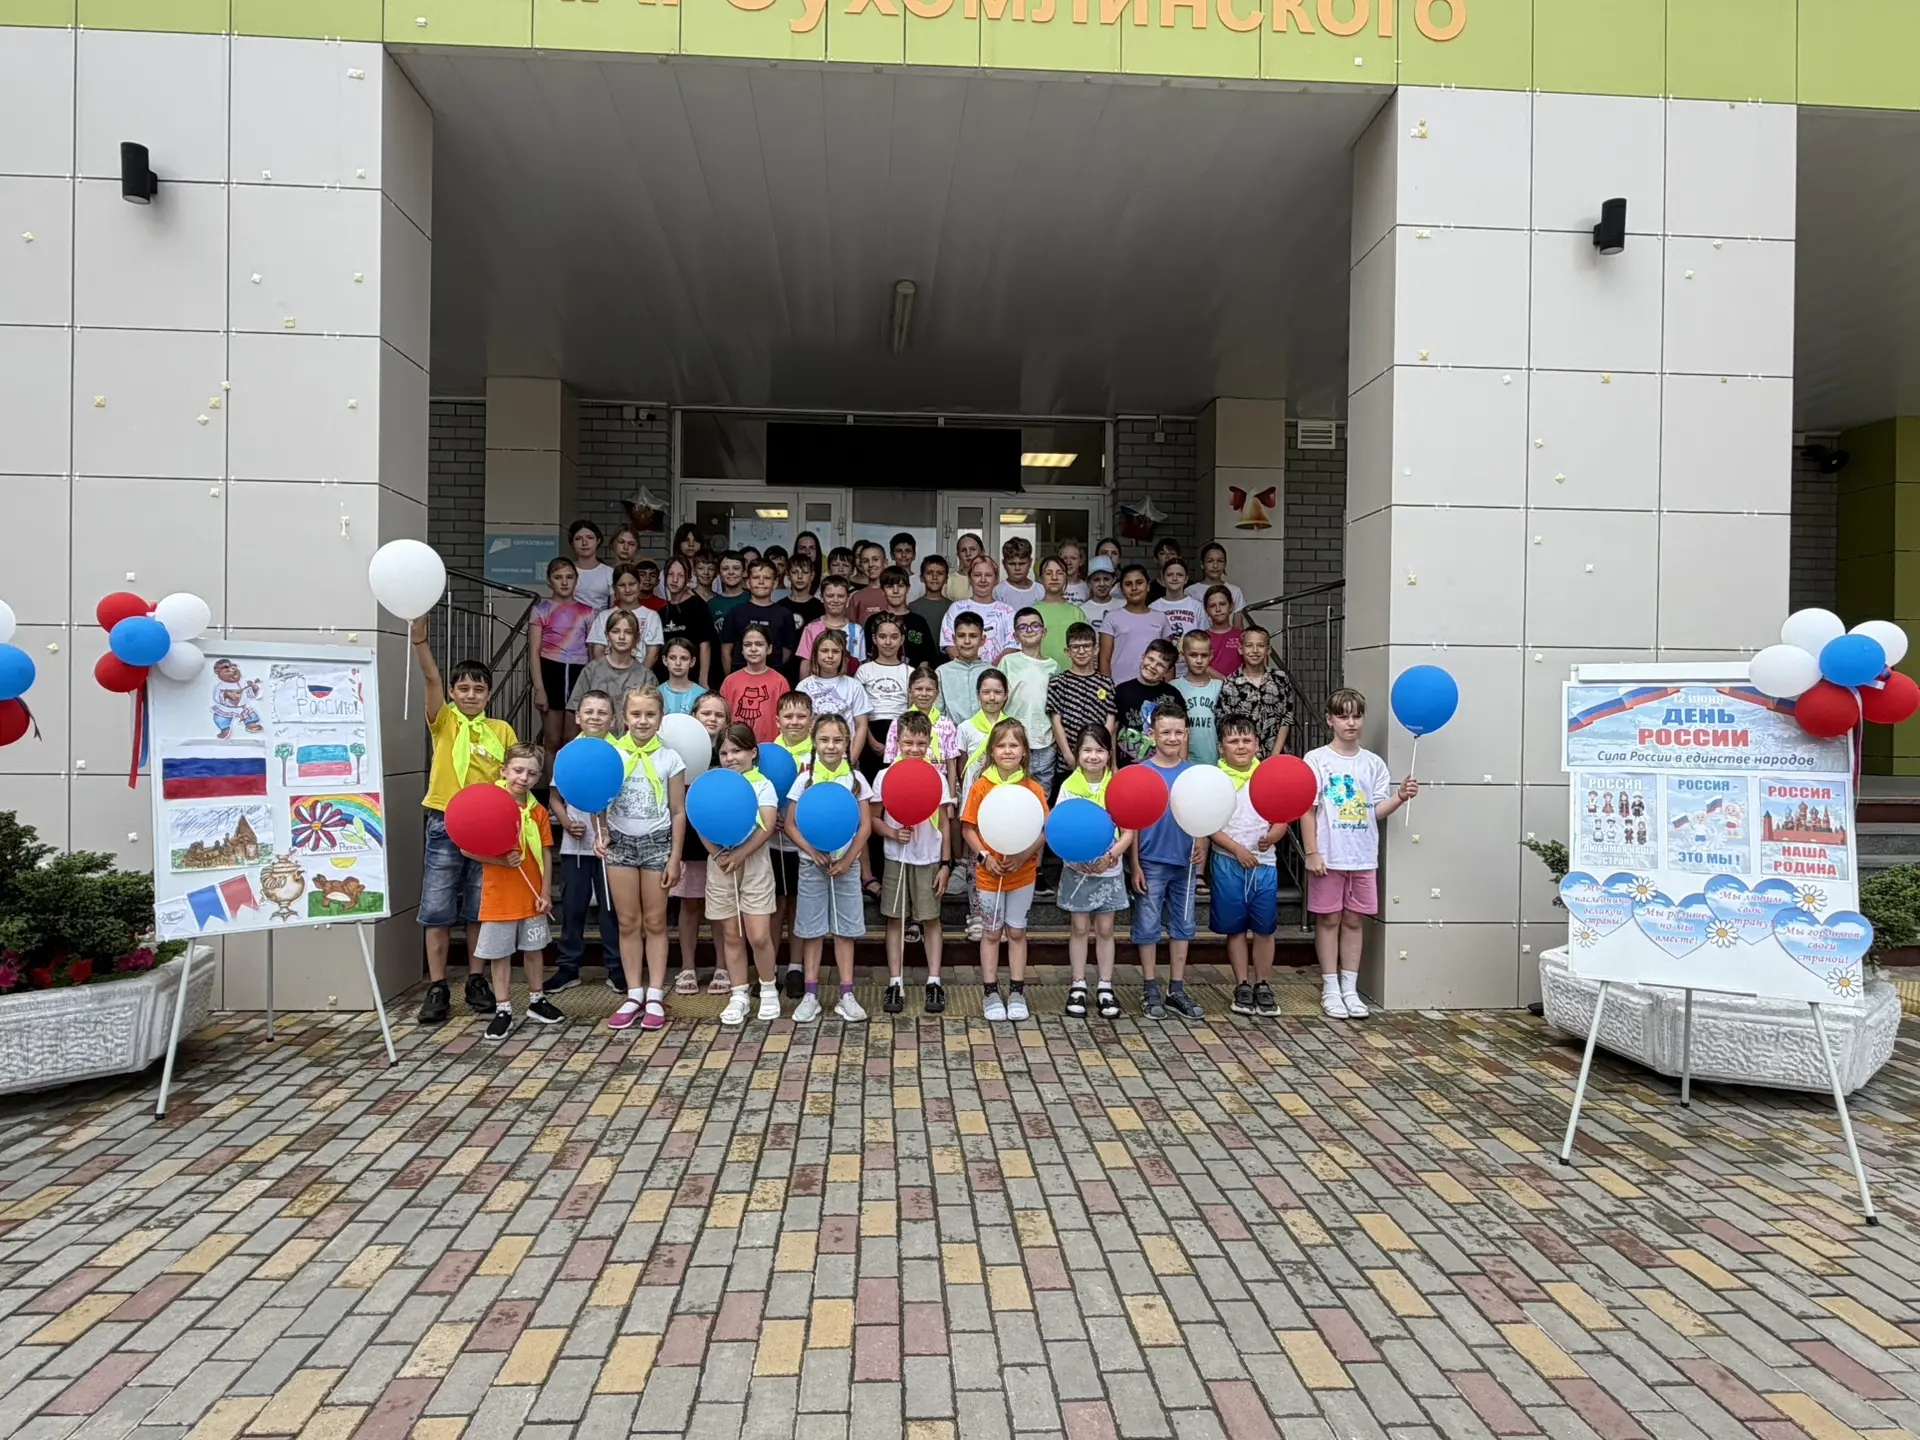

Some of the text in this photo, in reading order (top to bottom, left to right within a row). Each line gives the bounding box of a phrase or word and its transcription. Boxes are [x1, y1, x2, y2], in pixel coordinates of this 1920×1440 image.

[726, 0, 1467, 41] инского
[1673, 691, 1685, 704] 12
[1188, 716, 1212, 728] WAVE
[1662, 708, 1736, 726] ДЕНЬ
[1637, 728, 1750, 748] РОССИИ
[1597, 750, 1815, 768] Сила России в единстве народов
[1588, 777, 1643, 790] РОССИЯ
[1678, 780, 1730, 792] РОССИЯ
[1768, 786, 1832, 800] РОССИЯ
[1678, 851, 1704, 863] ЭТО
[1781, 845, 1828, 860] НАША
[1773, 861, 1837, 876] РОДИНА
[1719, 890, 1782, 904] Мы любим
[1642, 906, 1665, 918] Мы
[1737, 905, 1765, 915] свою
[1659, 922, 1695, 932] но мы
[1783, 925, 1861, 940] Мы гордимся
[1654, 934, 1698, 945] вместе!
[1797, 953, 1850, 965] страной!
